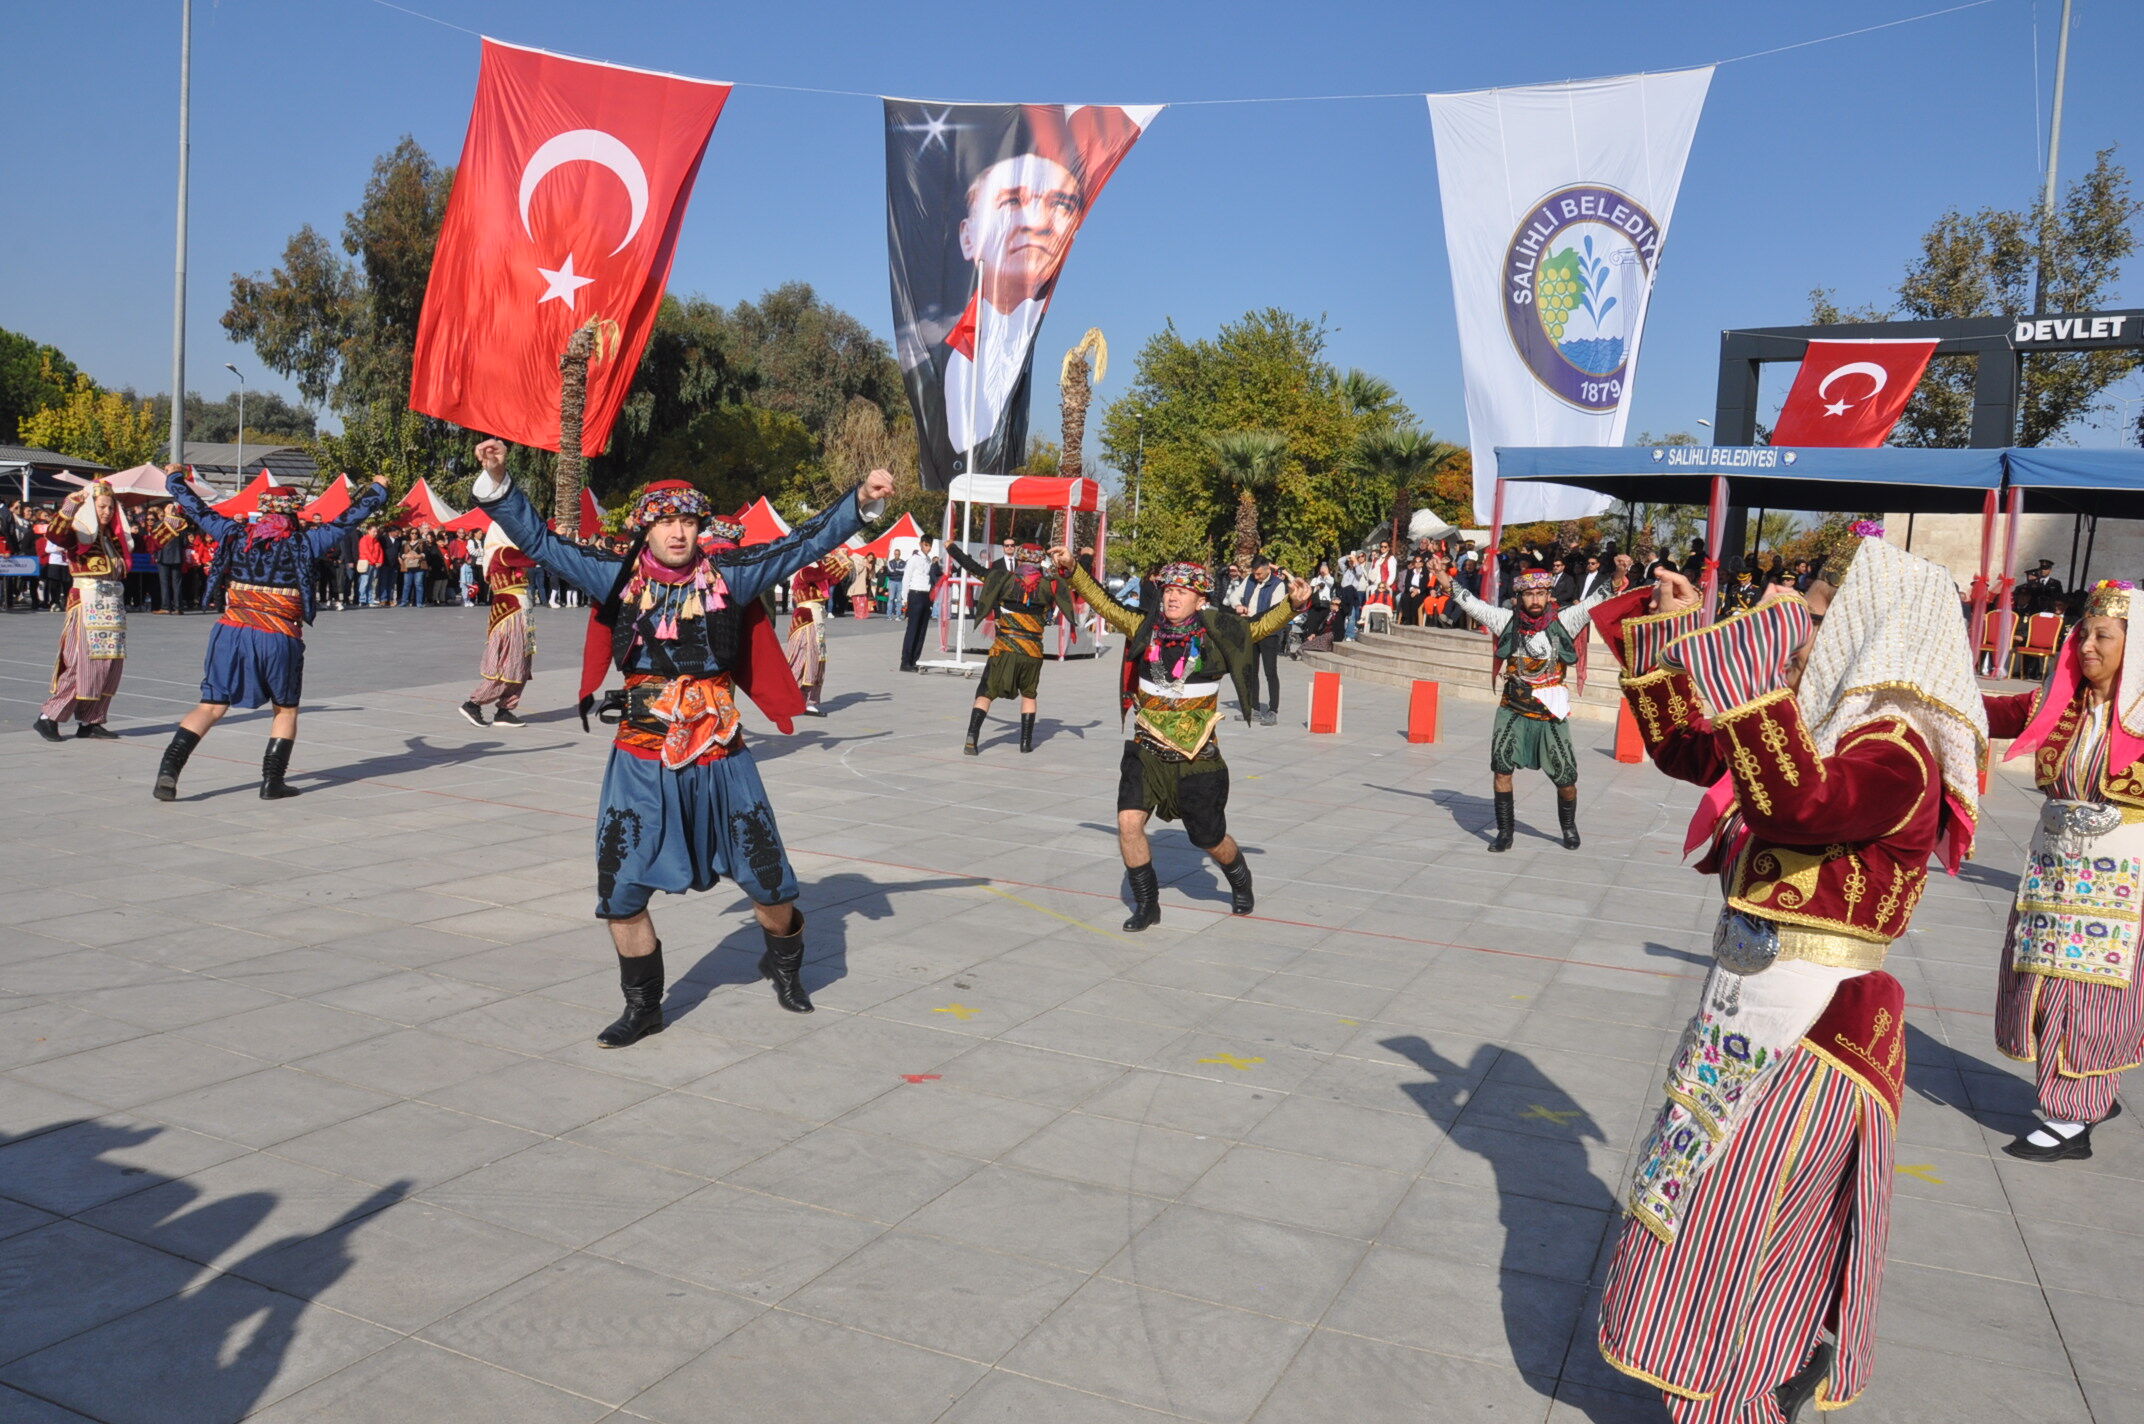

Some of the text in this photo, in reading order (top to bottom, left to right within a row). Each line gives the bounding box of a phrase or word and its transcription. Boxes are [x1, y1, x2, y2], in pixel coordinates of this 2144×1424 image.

[1513, 206, 1559, 305] SALİHLİ
[2015, 316, 2127, 342] DEVLET
[1580, 379, 1621, 402] 1879
[1668, 446, 1779, 468] SALİHLİ BELEDİYESİ
